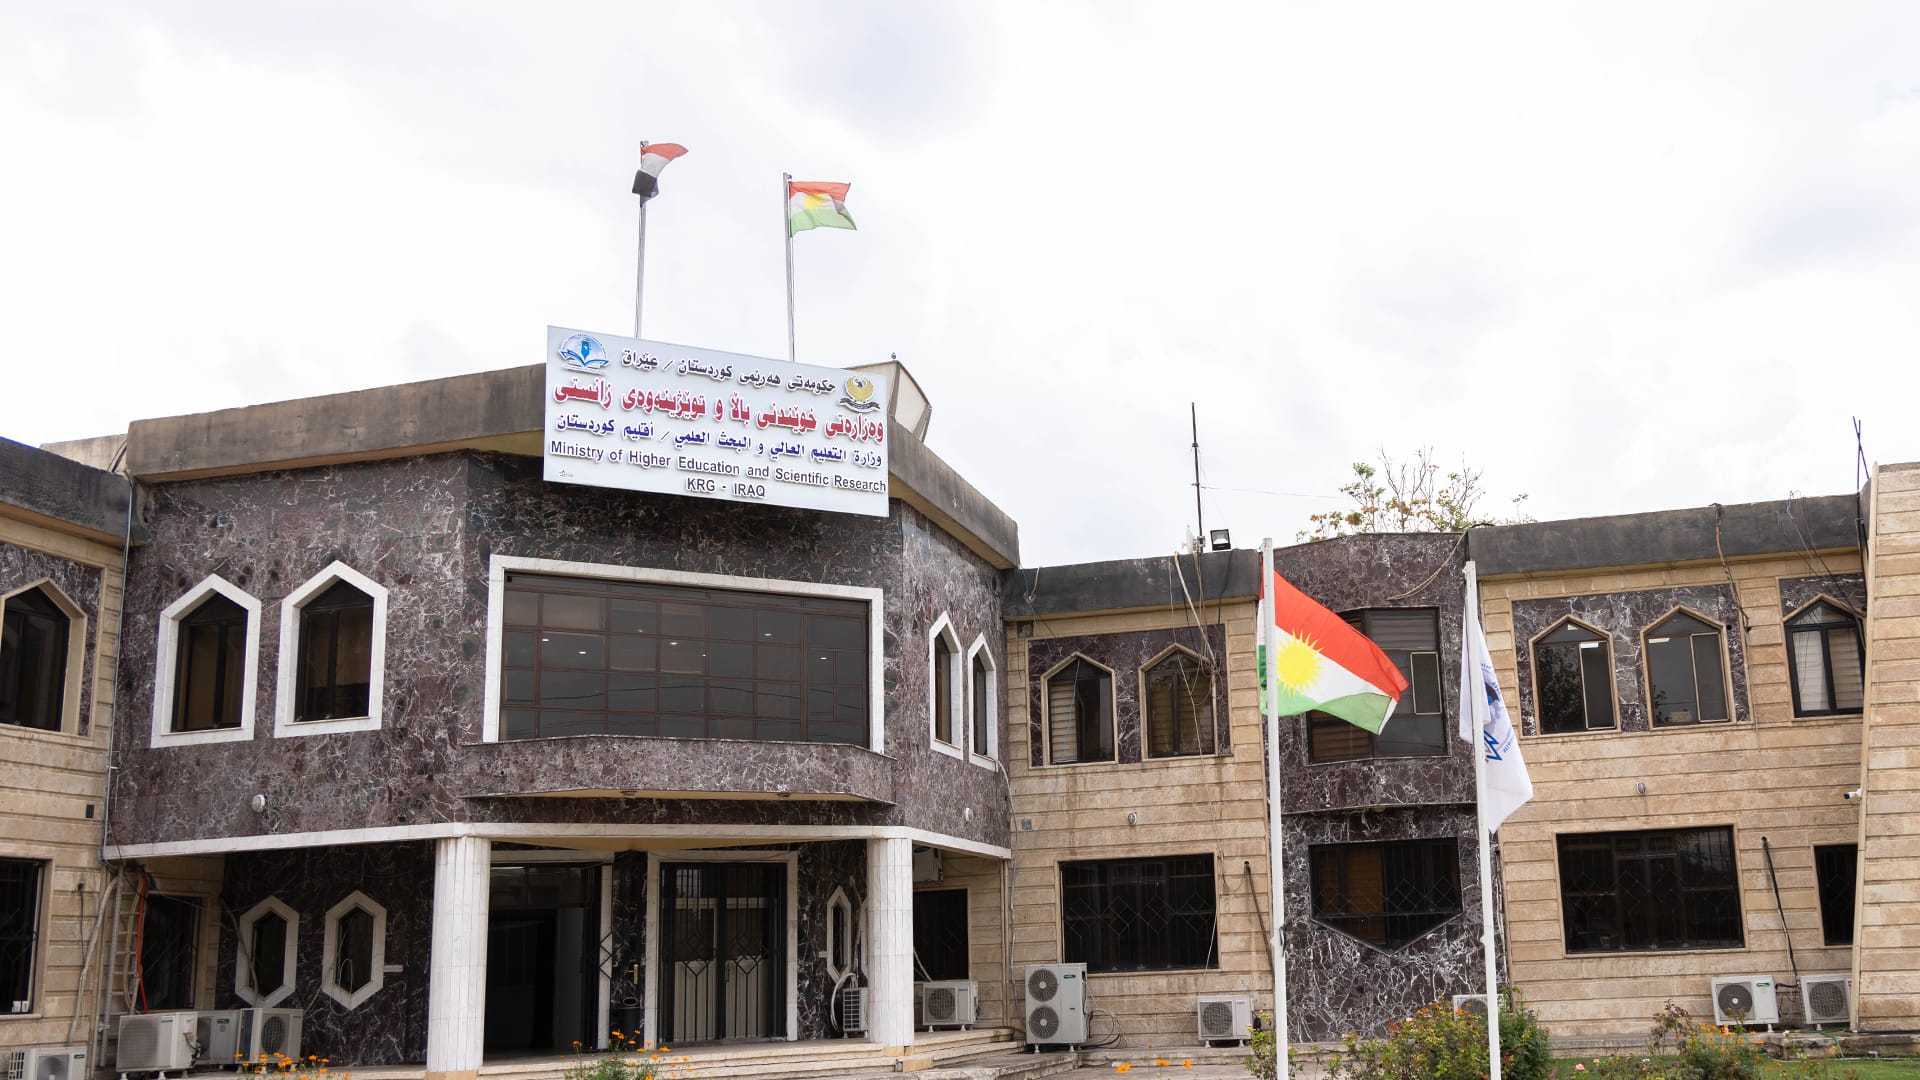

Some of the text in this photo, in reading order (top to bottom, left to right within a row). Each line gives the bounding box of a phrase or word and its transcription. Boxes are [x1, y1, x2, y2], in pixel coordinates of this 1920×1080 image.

[714, 398, 724, 420] و
[675, 431, 710, 447] العلمي
[718, 432, 751, 452] البحث
[757, 442, 764, 454] و
[770, 441, 804, 459] العالي
[811, 445, 846, 461] التعليم
[854, 449, 882, 466] وزارة
[551, 440, 886, 492] Ministry of Higher Education and Scientific Research
[687, 477, 716, 492] KRG
[734, 482, 766, 497] IRAQ
